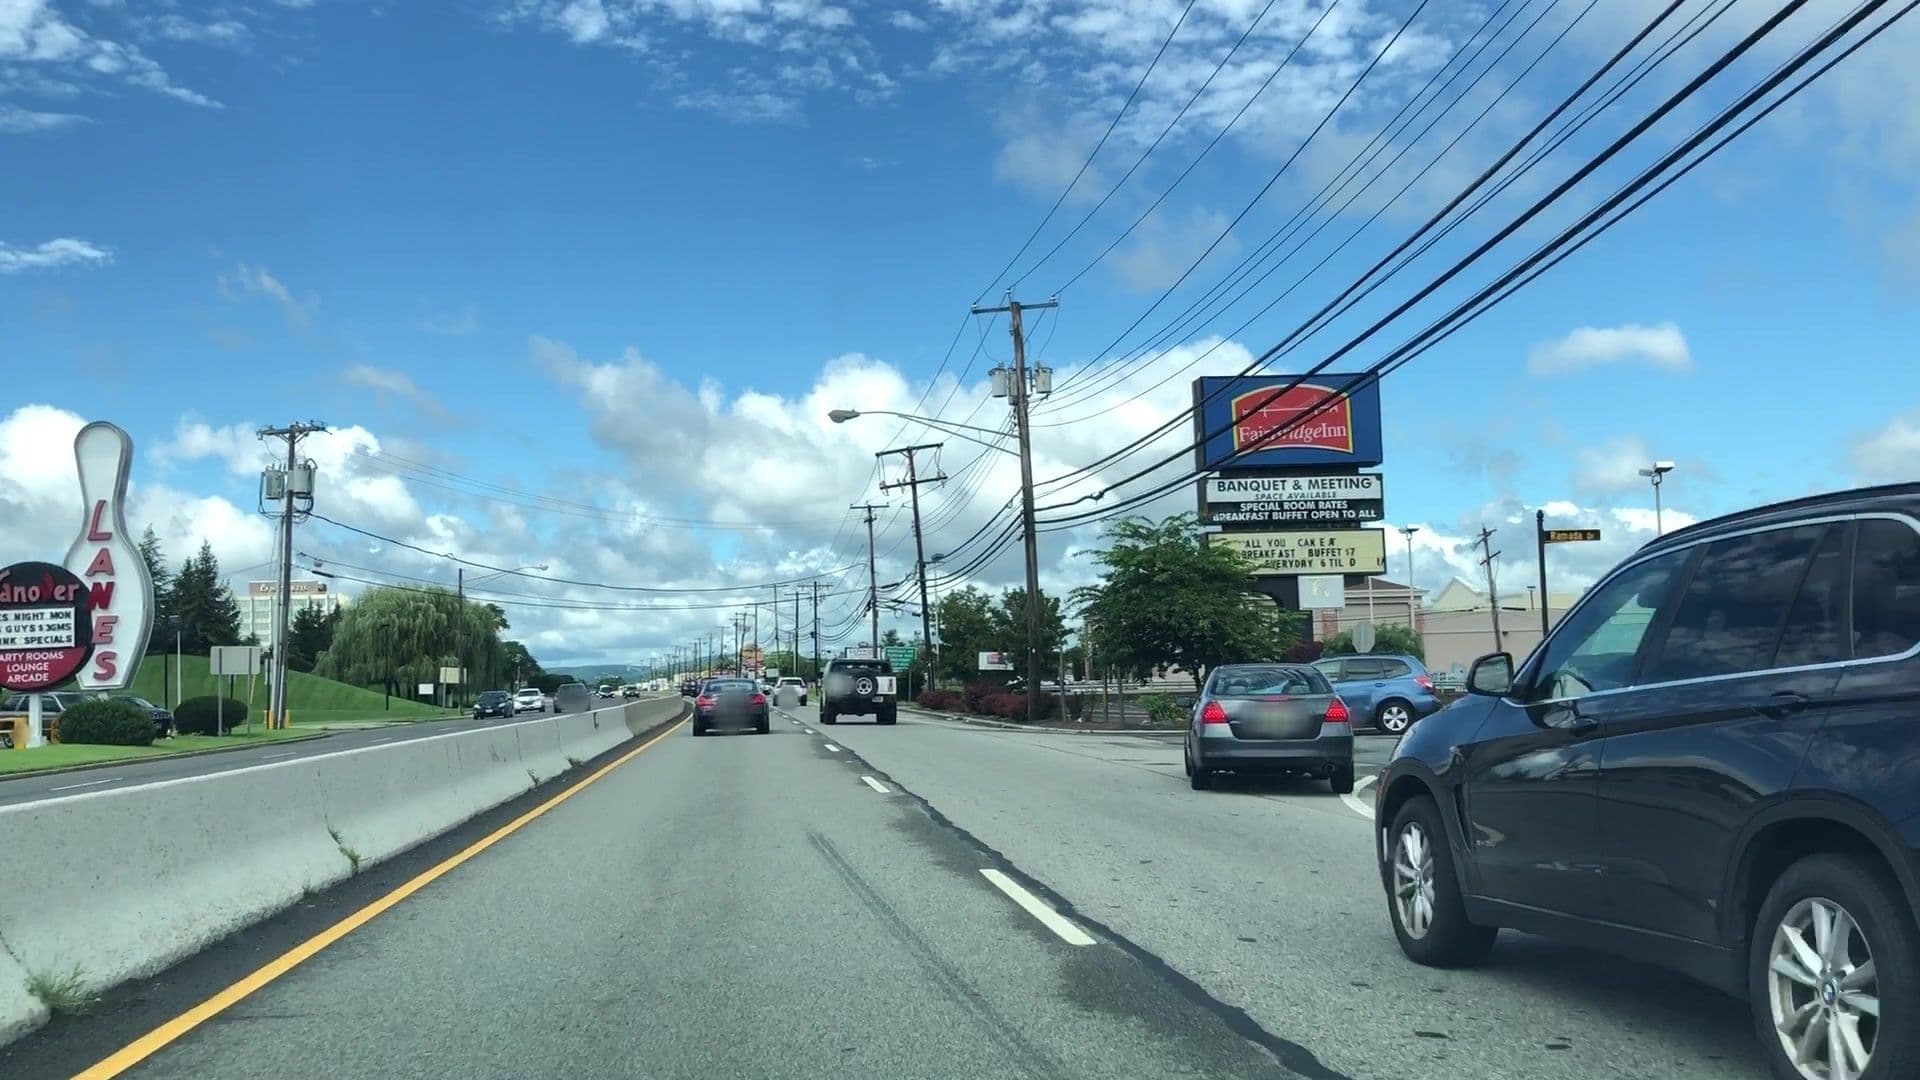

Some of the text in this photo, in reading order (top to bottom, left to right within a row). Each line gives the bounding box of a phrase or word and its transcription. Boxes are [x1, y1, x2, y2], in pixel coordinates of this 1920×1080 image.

[1217, 477, 1372, 492] BANQUET & MEETING
[1287, 491, 1336, 499] AVAILABLE
[1239, 500, 1348, 512] SPECIAL ROOM RATES
[1271, 510, 1309, 520] BUFFET
[1310, 510, 1340, 519] OPEN
[1341, 510, 1356, 518] TO
[1358, 509, 1377, 518] ALL
[1245, 539, 1262, 548] ALL
[1267, 538, 1286, 548] YOU
[1297, 537, 1315, 547] CAN
[1241, 549, 1295, 560] BREAKFAST
[1307, 547, 1342, 557] BUFFET
[1319, 559, 1327, 568] 6
[1328, 558, 1344, 567] TIL
[85, 499, 119, 682] LANES
[14, 611, 44, 621] NIGHT
[50, 611, 71, 620] MON
[5, 624, 36, 633] GUYS
[24, 634, 73, 645] SPECIALS
[26, 650, 65, 661] ROOMS
[6, 662, 49, 672] LOUNGE
[6, 673, 49, 683] ARCADE
